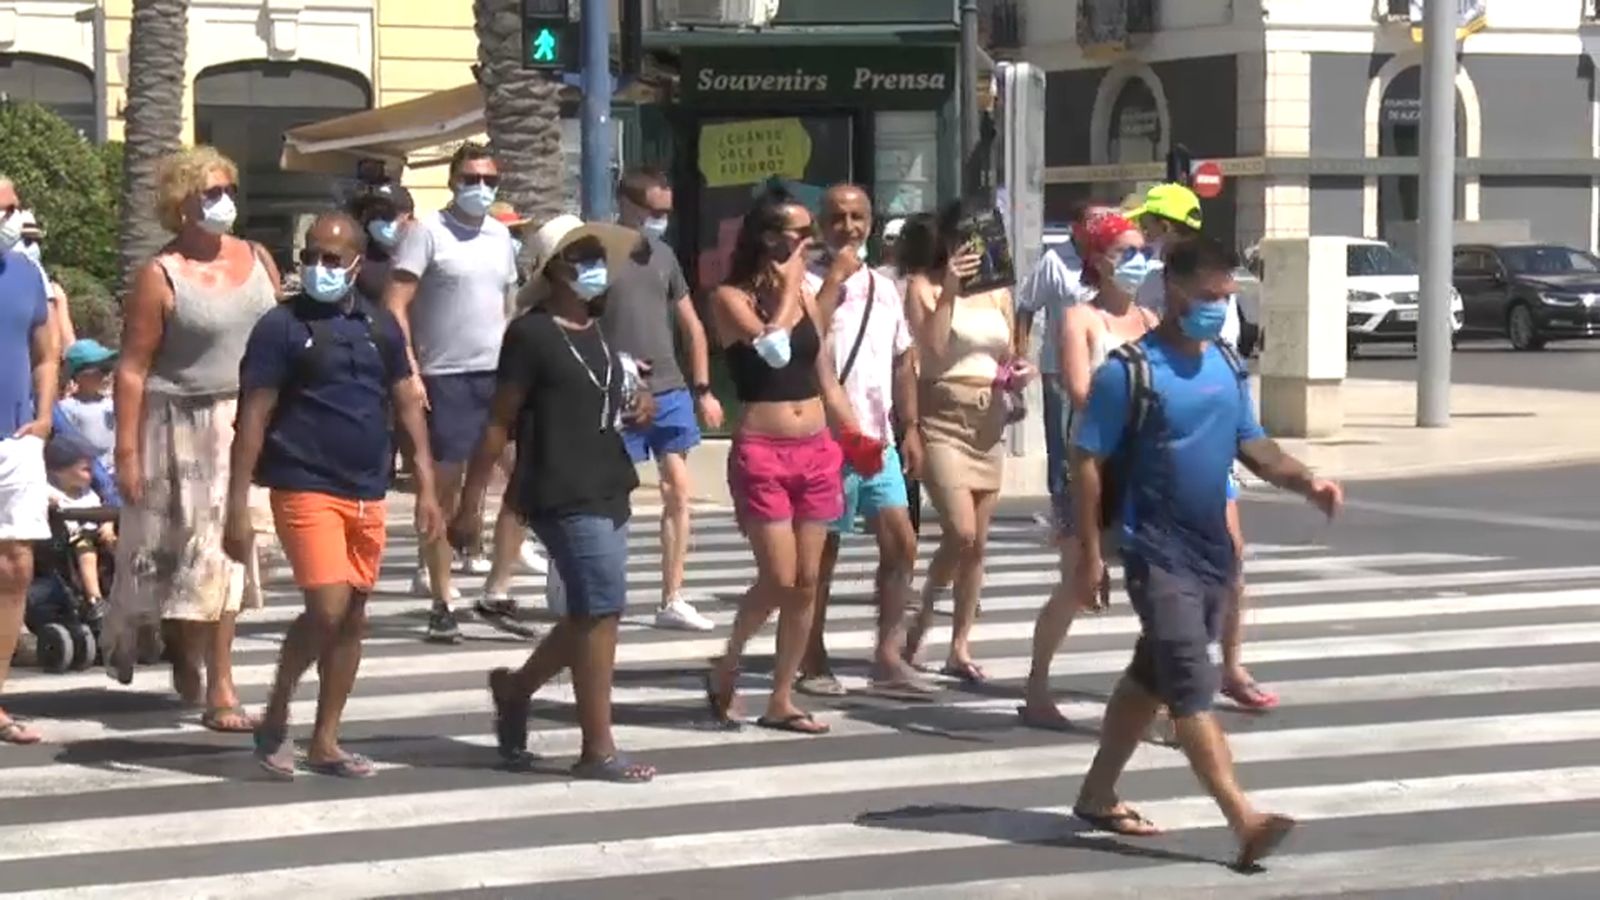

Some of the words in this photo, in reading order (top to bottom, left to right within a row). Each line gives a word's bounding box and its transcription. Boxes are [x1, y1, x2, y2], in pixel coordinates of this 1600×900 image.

[697, 68, 828, 91] Souvenirs
[853, 68, 945, 89] Prensa
[718, 146, 754, 160] VALE
[766, 143, 785, 157] EL
[720, 158, 785, 174] FUTURO?
